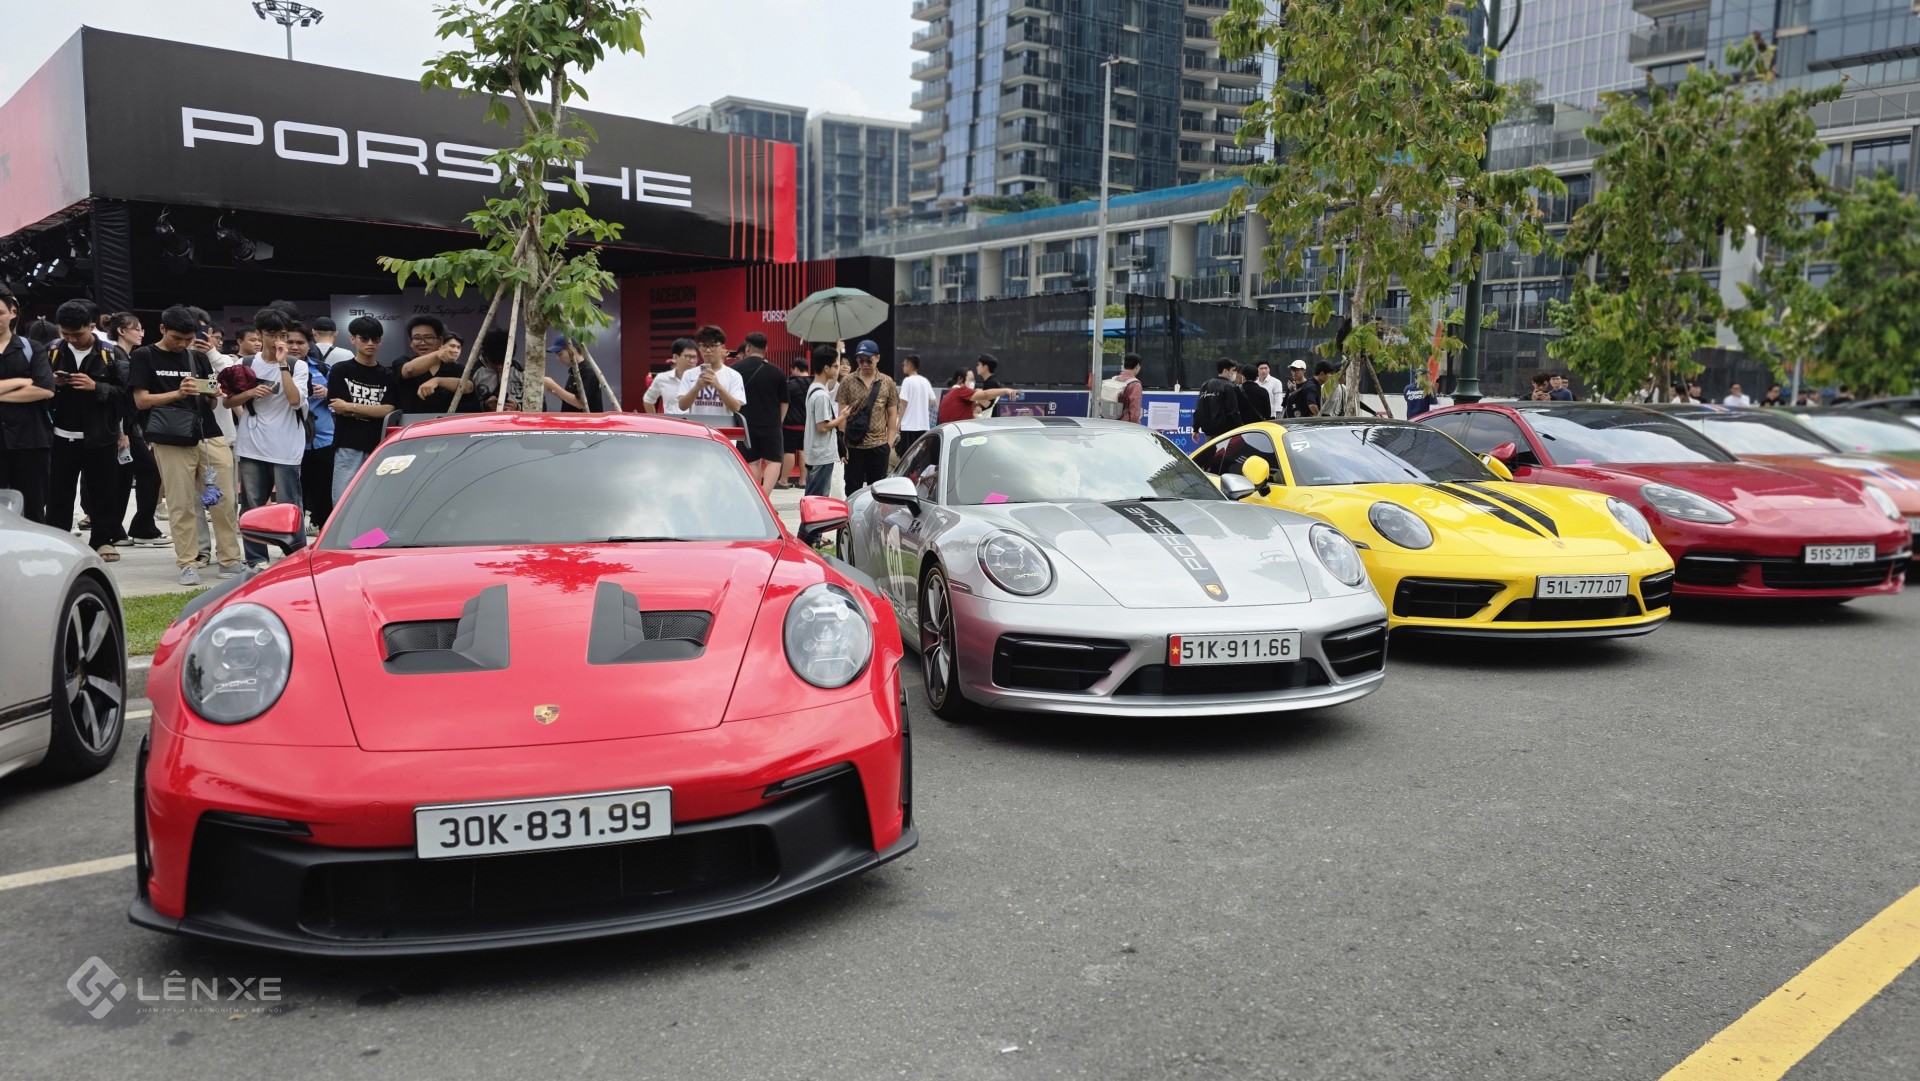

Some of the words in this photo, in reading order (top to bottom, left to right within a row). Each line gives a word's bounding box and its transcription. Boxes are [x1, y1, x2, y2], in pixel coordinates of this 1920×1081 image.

[181, 106, 693, 208] PORSCHE
[649, 284, 697, 304] RACEBORN
[412, 304, 431, 314] 718
[431, 305, 477, 318] Spyder
[762, 309, 789, 323] PORSCH
[1123, 507, 1209, 571] PORSCHE
[1810, 547, 1871, 561] 51S-217.85
[1546, 579, 1623, 594] 51L-777.07
[1182, 638, 1291, 659] 51K-911.66
[438, 800, 652, 849] 30K-831.99
